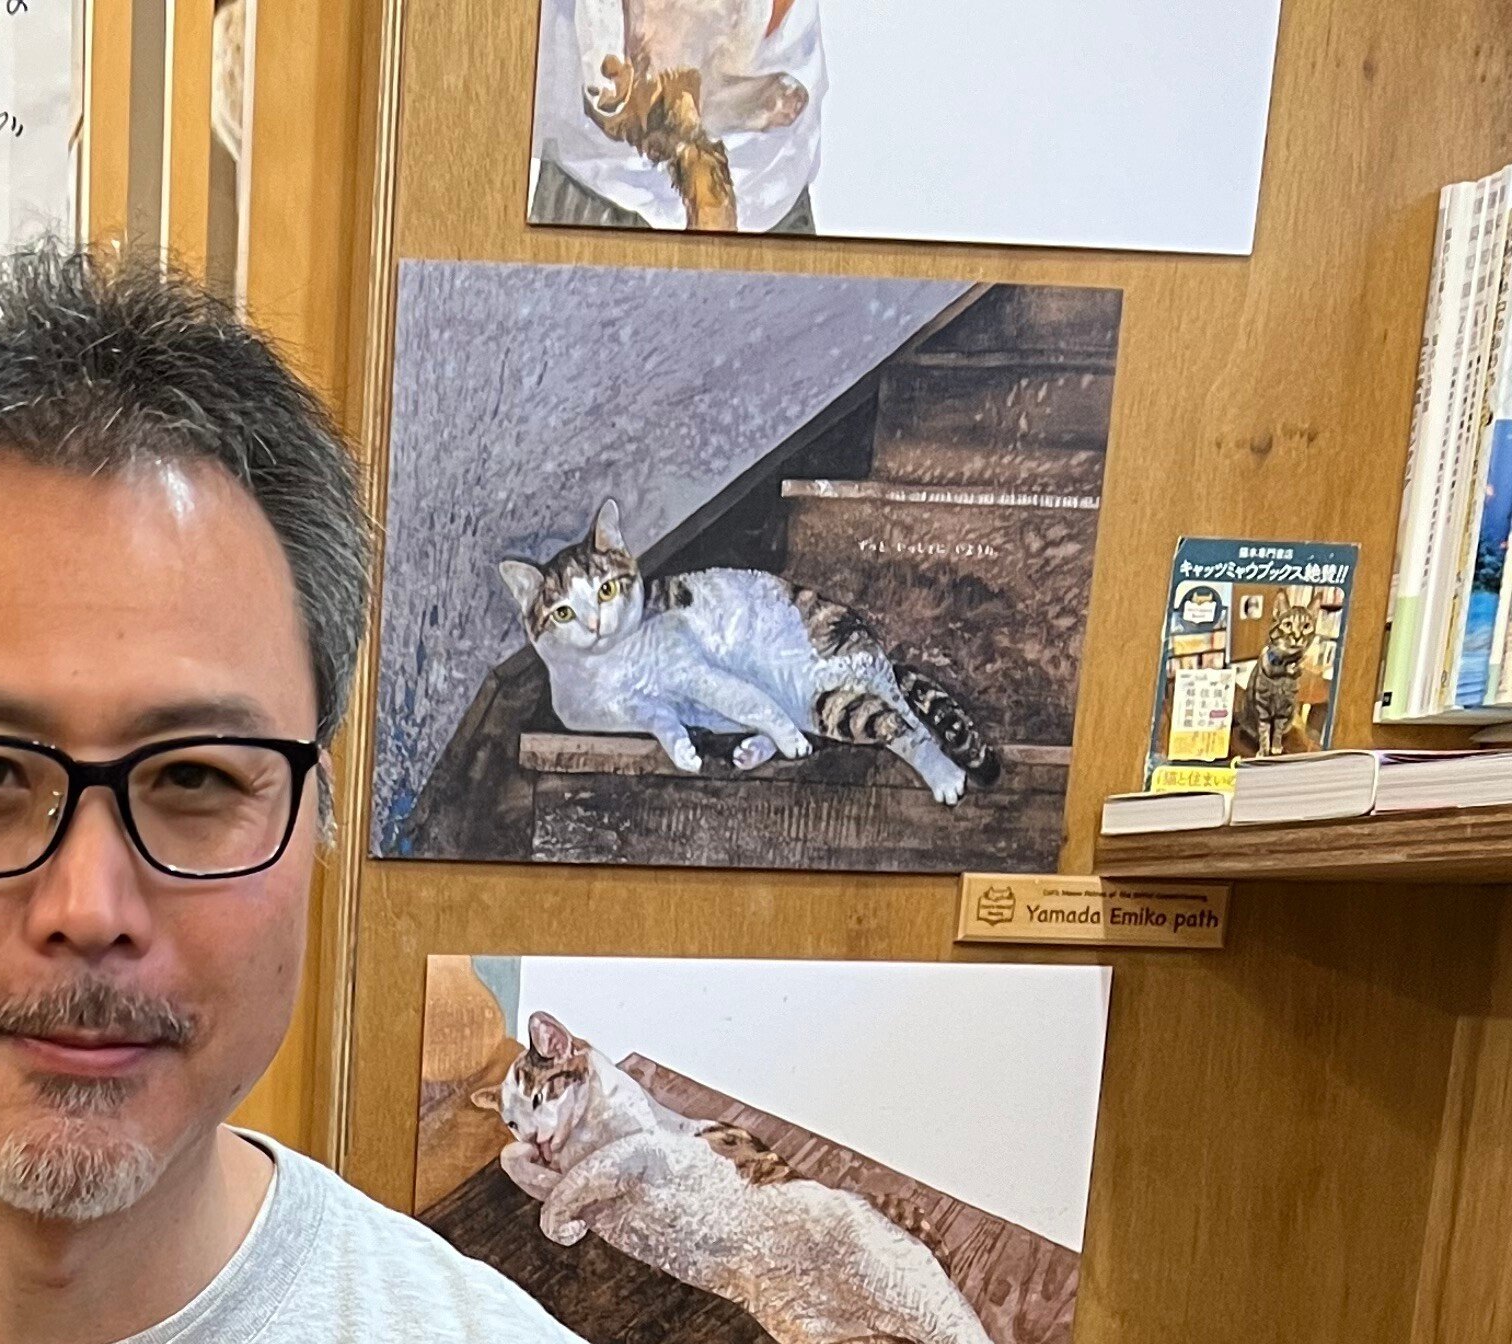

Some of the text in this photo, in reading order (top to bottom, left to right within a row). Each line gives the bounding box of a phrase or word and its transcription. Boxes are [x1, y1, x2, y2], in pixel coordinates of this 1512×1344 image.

[1026, 903, 1101, 925] Yamada
[1109, 906, 1167, 927] Emiko
[1173, 908, 1219, 933] path
